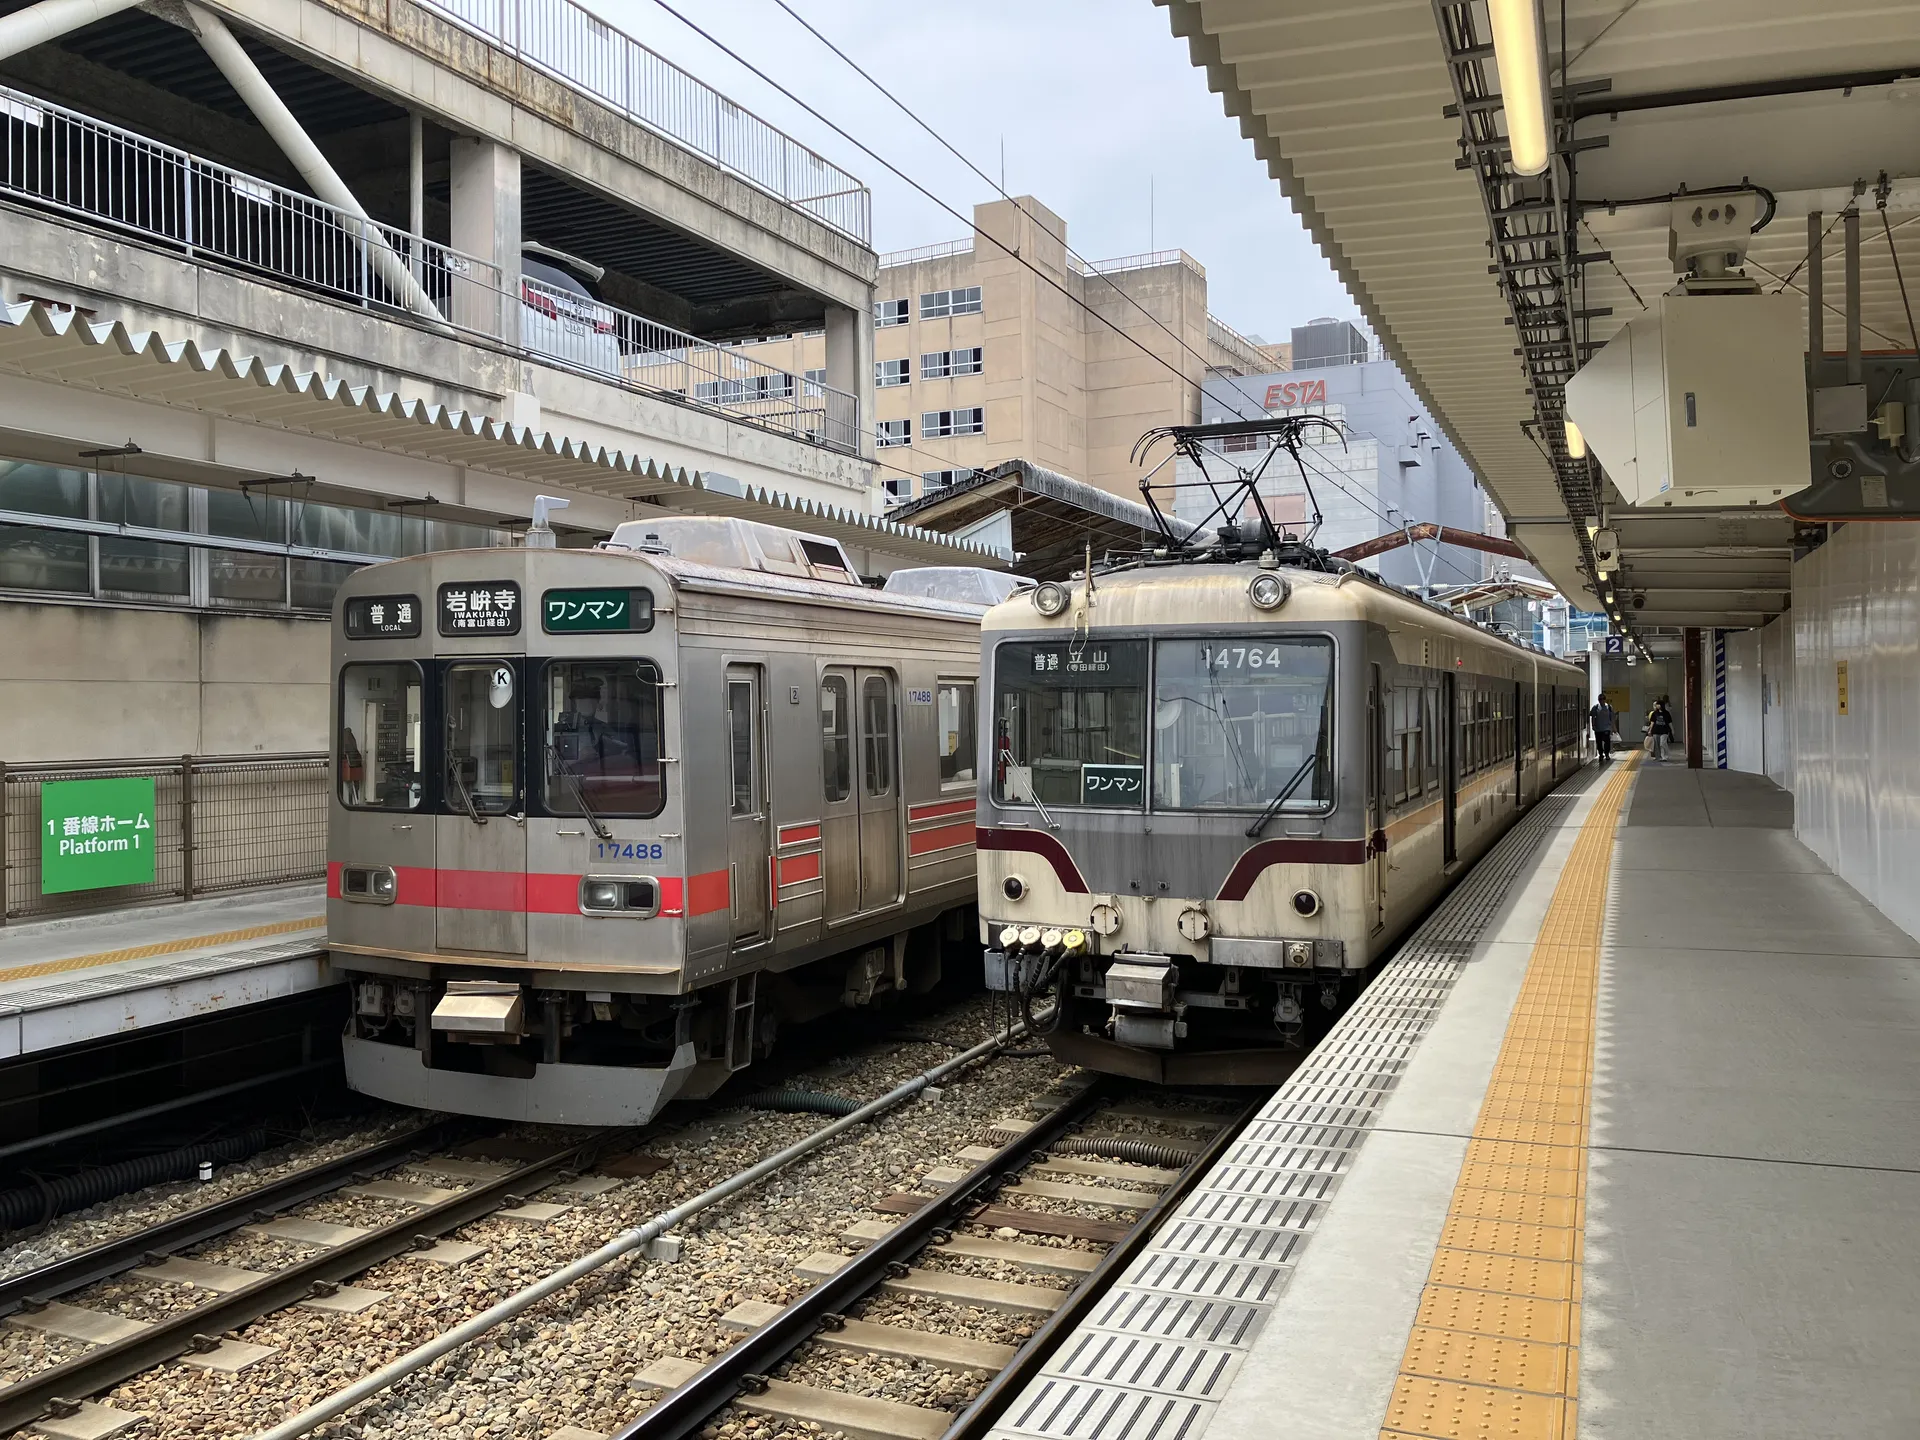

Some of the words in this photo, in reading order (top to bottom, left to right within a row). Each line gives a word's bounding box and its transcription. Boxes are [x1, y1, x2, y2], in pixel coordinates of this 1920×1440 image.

[1263, 379, 1328, 409] ESTA
[370, 603, 412, 624] 普通
[548, 600, 625, 622] ワンマン
[380, 624, 402, 632] LOCAL
[1608, 638, 1620, 653] 2
[1069, 650, 1107, 664] 立山
[1206, 648, 1281, 669] 14764
[497, 671, 508, 685] K
[908, 690, 931, 702] 17488
[1085, 775, 1141, 793] ワンマン
[59, 837, 128, 856] Platform
[132, 834, 140, 849] 1
[597, 843, 663, 859] 17488
